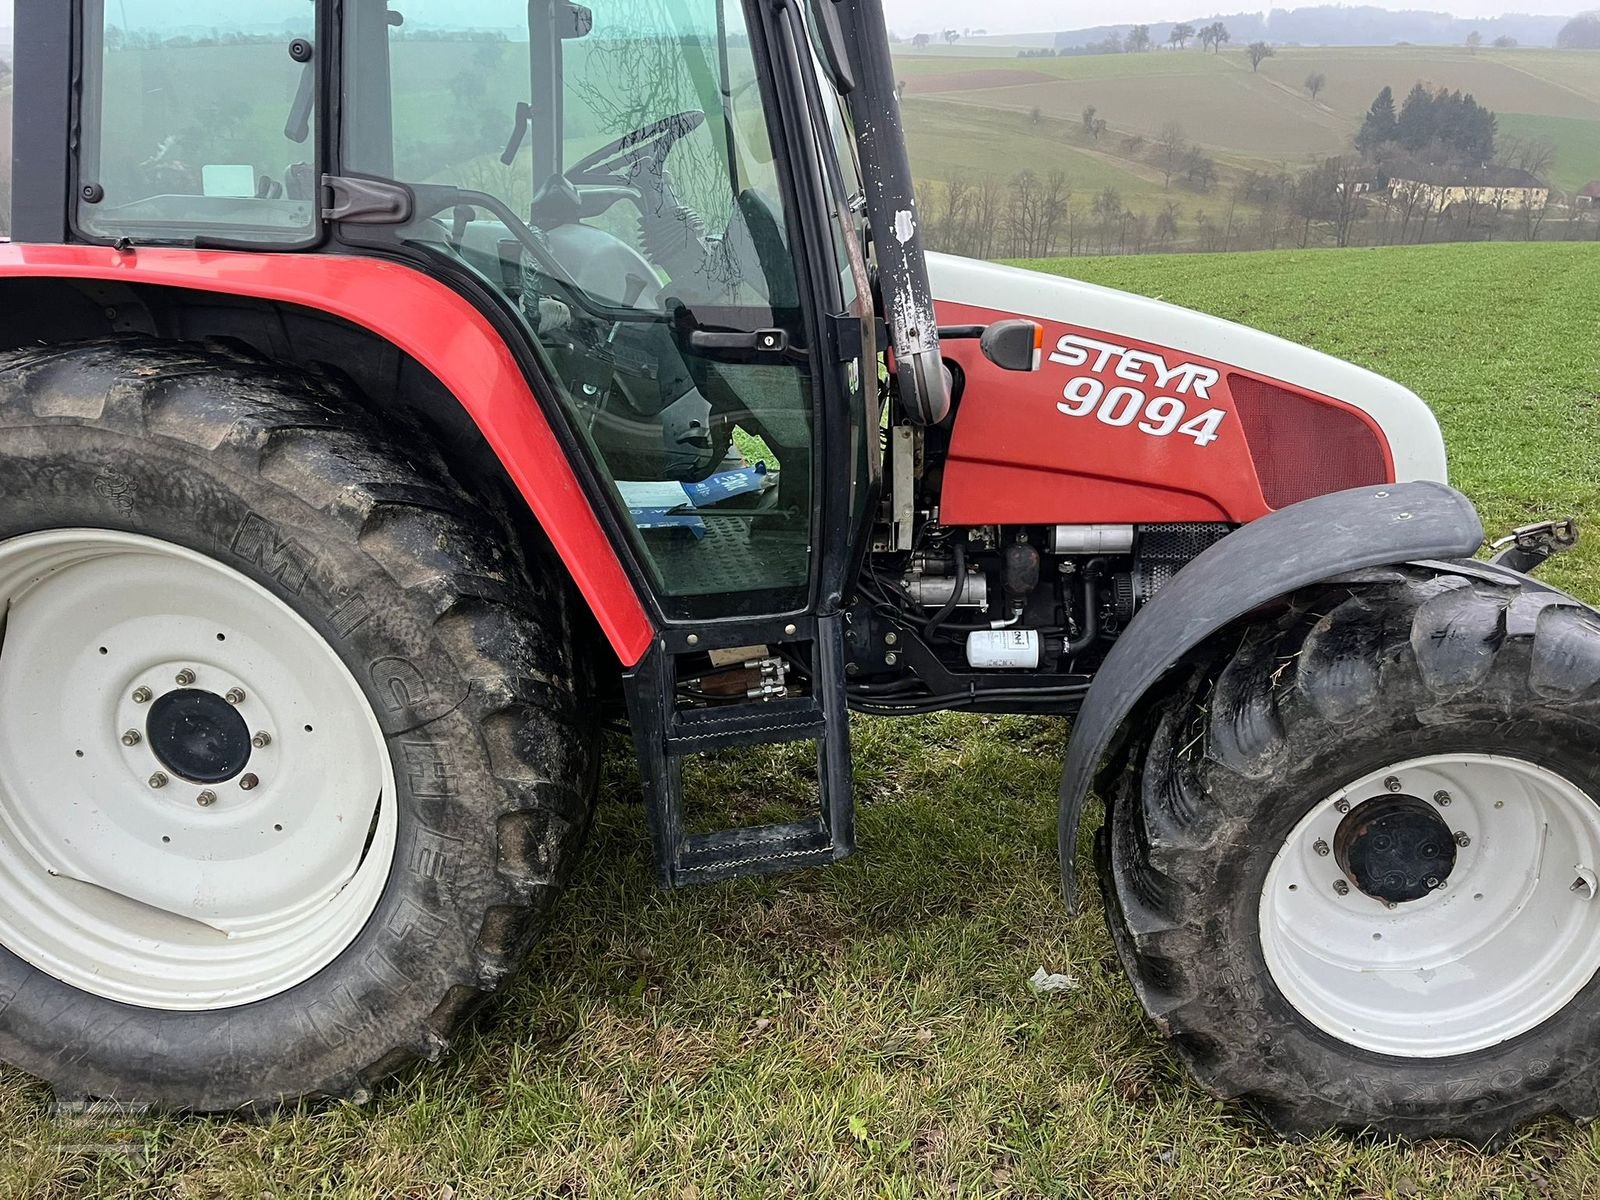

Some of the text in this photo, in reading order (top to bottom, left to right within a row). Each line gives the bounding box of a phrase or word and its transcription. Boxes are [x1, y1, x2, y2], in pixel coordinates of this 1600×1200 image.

[1048, 333, 1220, 399] STEYR
[1056, 376, 1227, 447] 9094
[231, 511, 465, 1047] MICHELIN
